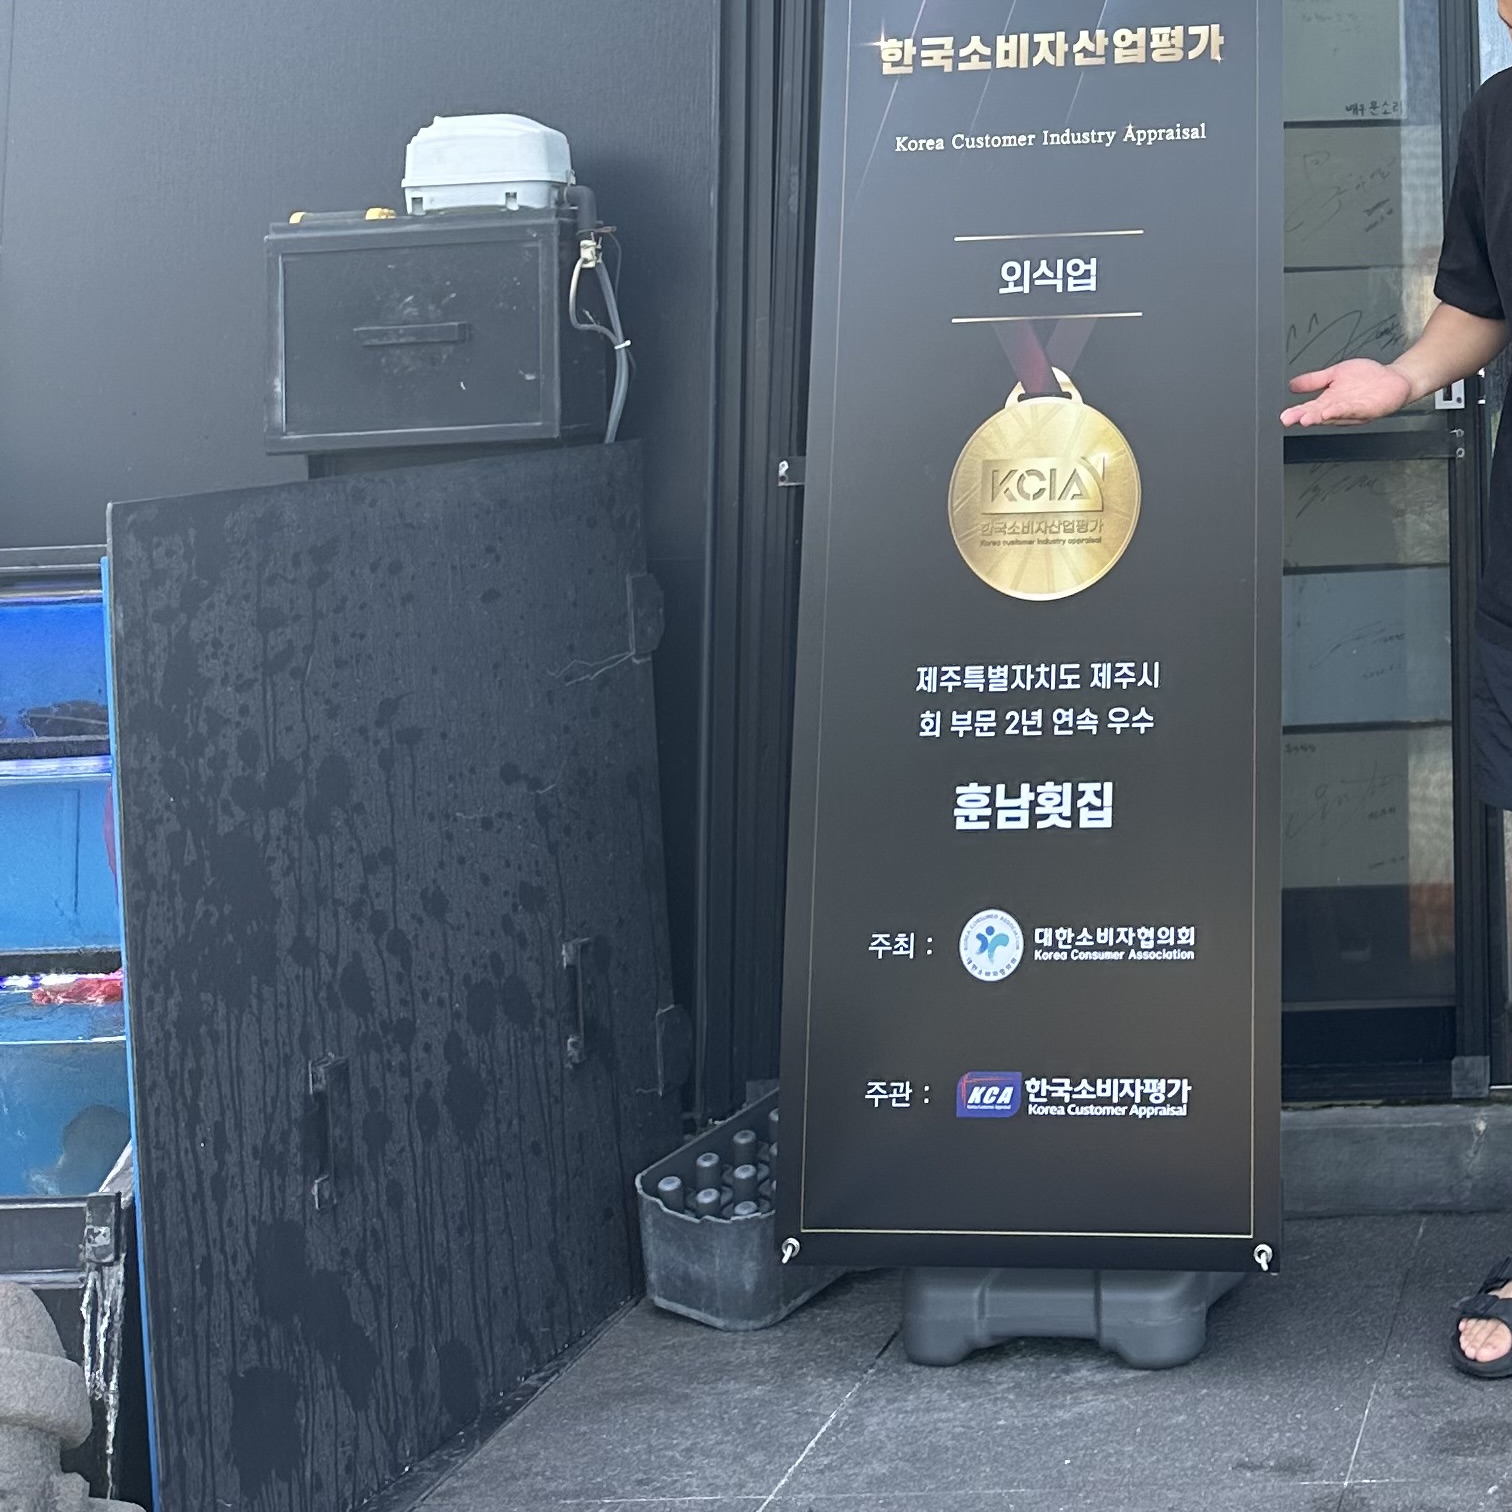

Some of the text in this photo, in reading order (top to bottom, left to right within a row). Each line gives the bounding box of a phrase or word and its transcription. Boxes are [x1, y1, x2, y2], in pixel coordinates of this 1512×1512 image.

[879, 23, 1225, 77] 한국소비자산업평가
[894, 122, 1207, 153] Korea Customer Industry Appraisal
[998, 257, 1098, 295] 외식업
[991, 468, 1090, 503] KCIA
[981, 518, 1104, 537] 한국소비자산업평가
[915, 660, 1160, 693] 제주특별자치도 제주시
[918, 706, 1155, 738] 회 부문 2년 연속 우수
[953, 781, 1114, 831] 훈남횟집
[868, 932, 915, 959] 주최
[1034, 925, 1196, 949] 대한소비자협의회
[1034, 948, 1195, 961] Korea Consumer Association
[864, 1080, 913, 1109] 주관
[967, 1086, 1015, 1104] KCA
[1024, 1077, 1192, 1104] 한국소비자평가
[1028, 1102, 1188, 1119] Korea Customer Appraisal
